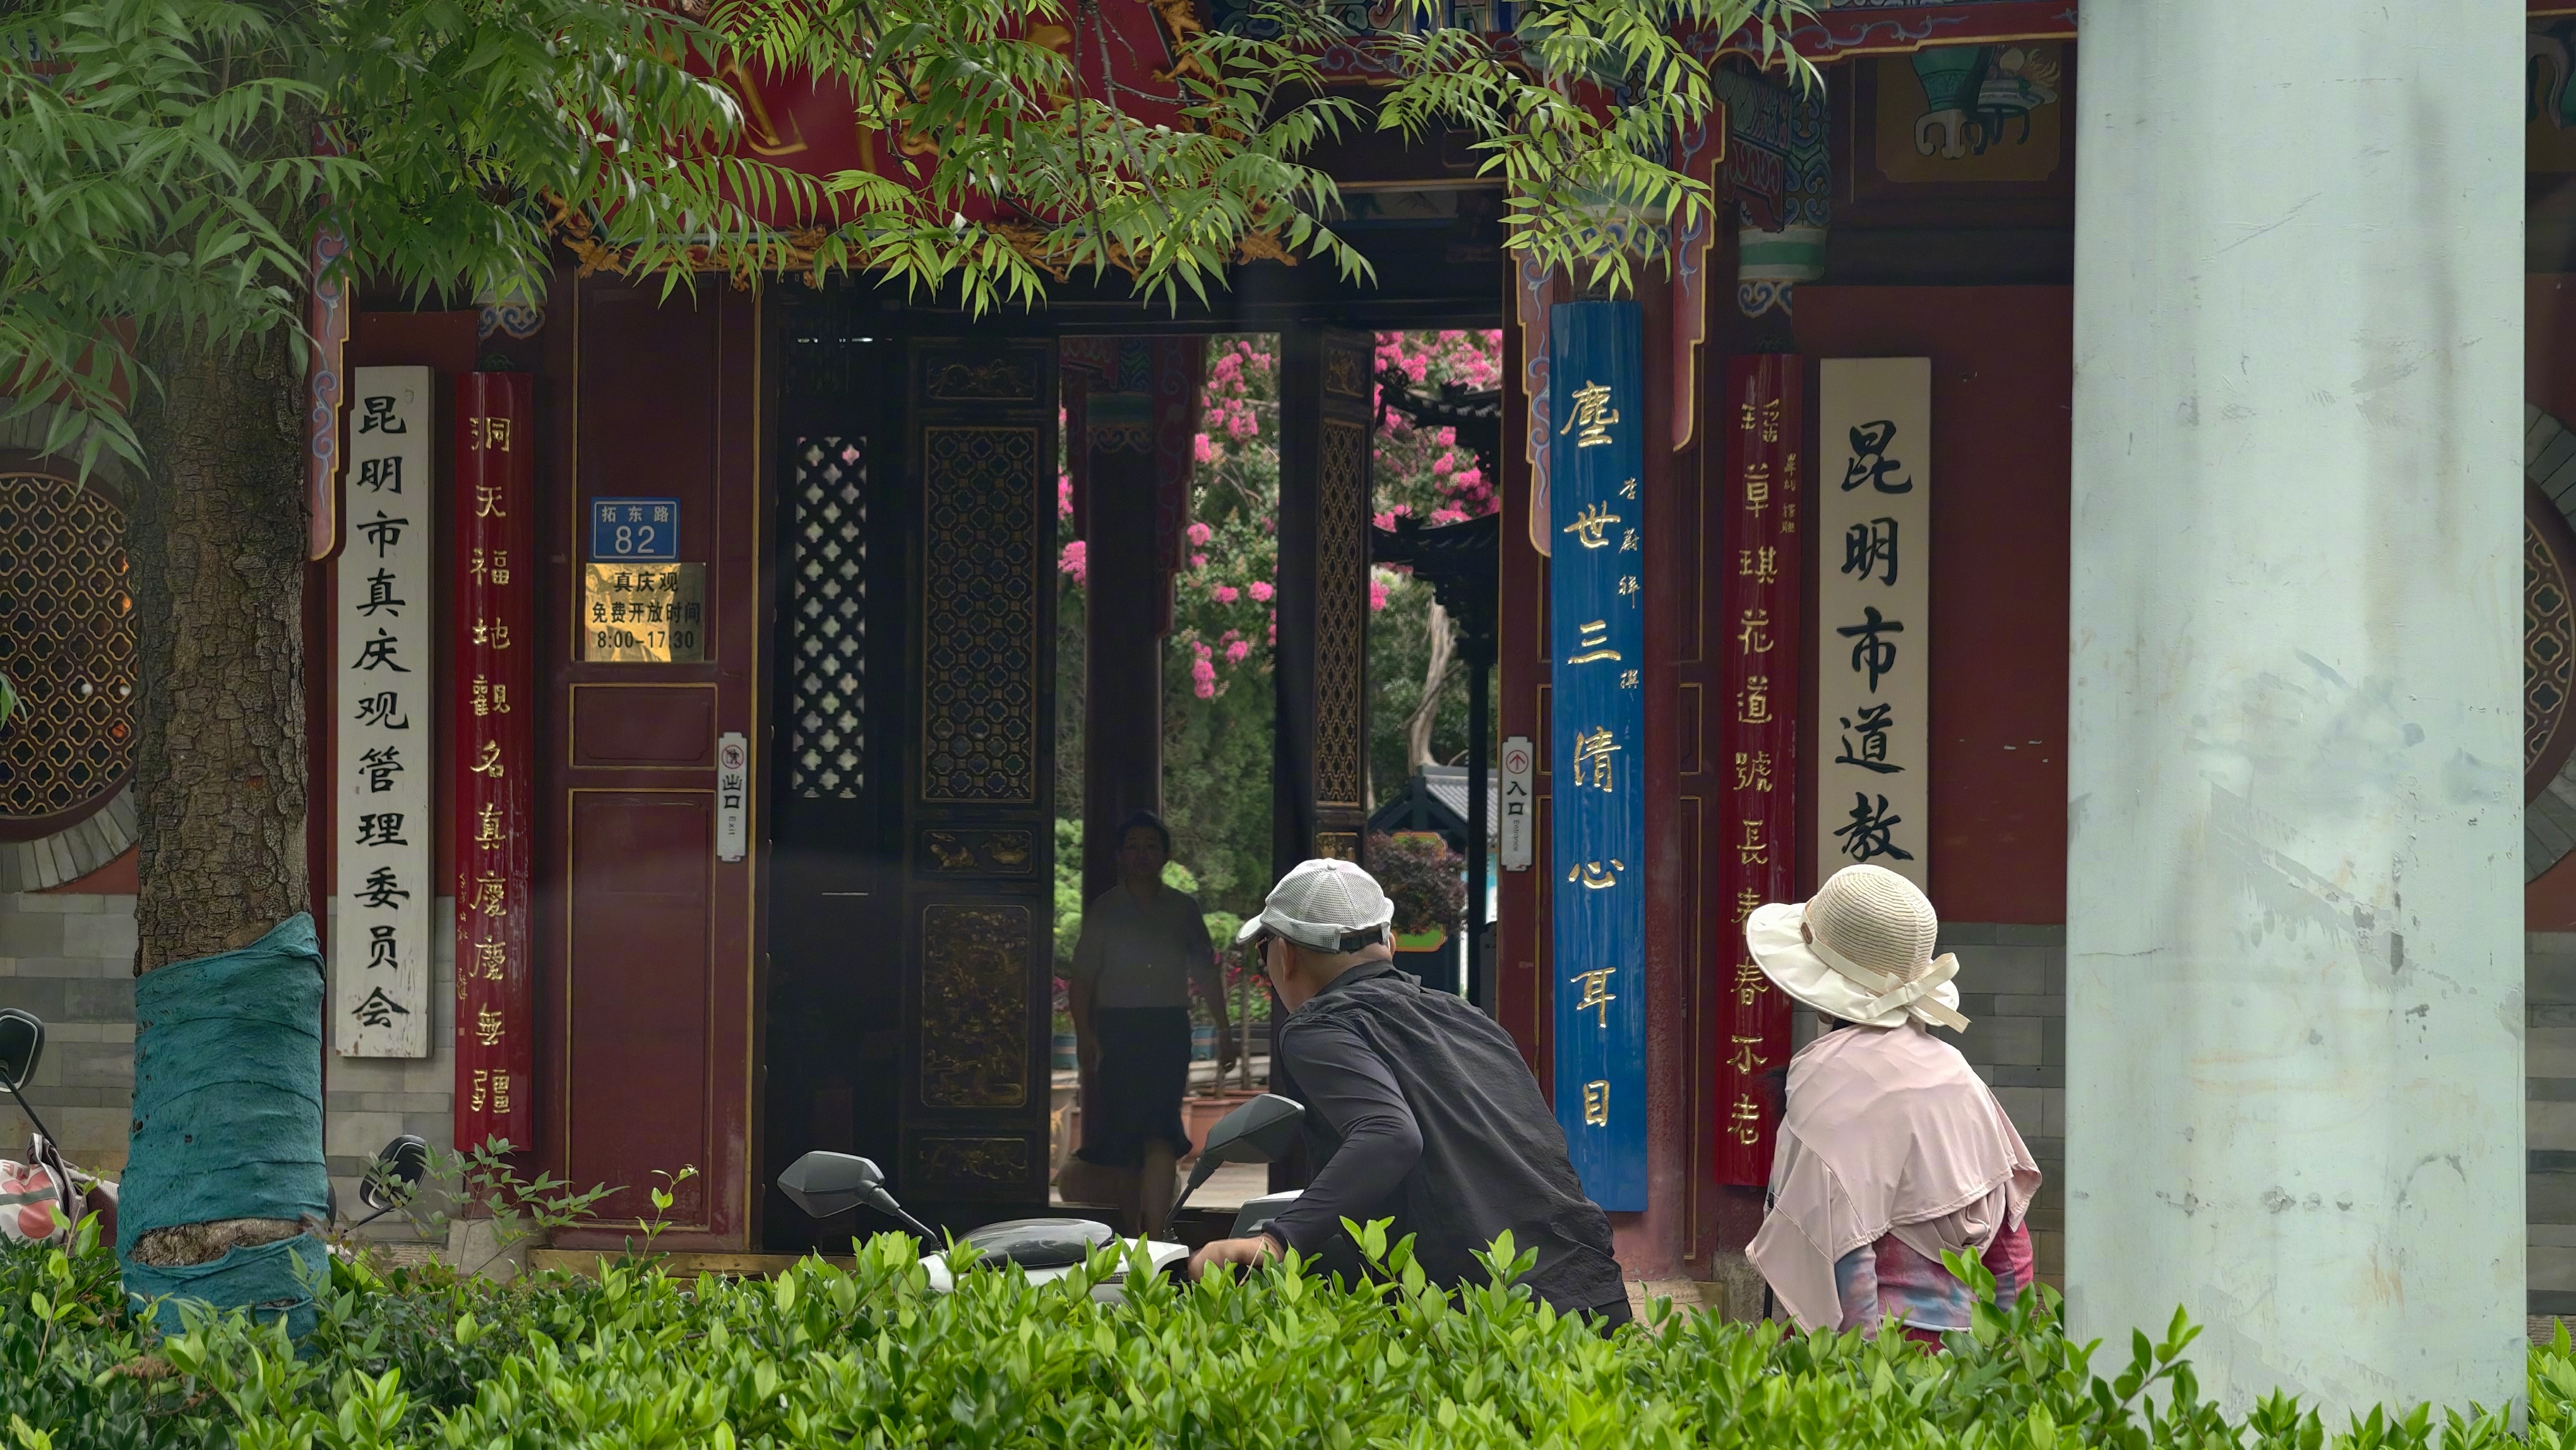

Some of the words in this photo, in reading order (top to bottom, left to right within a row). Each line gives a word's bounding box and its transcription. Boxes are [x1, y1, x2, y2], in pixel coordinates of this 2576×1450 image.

[602, 506, 669, 523] 拓东路
[615, 525, 655, 554] 82
[613, 572, 678, 592] 真庆观
[592, 601, 701, 624] 免费开放时间
[597, 631, 695, 649] 8:00-17:30
[1833, 421, 1914, 861] 昆明市道教
[351, 396, 412, 1029] 昆明市真庆观管理委员会
[722, 774, 743, 809] 出口
[1506, 781, 1527, 815] 入口
